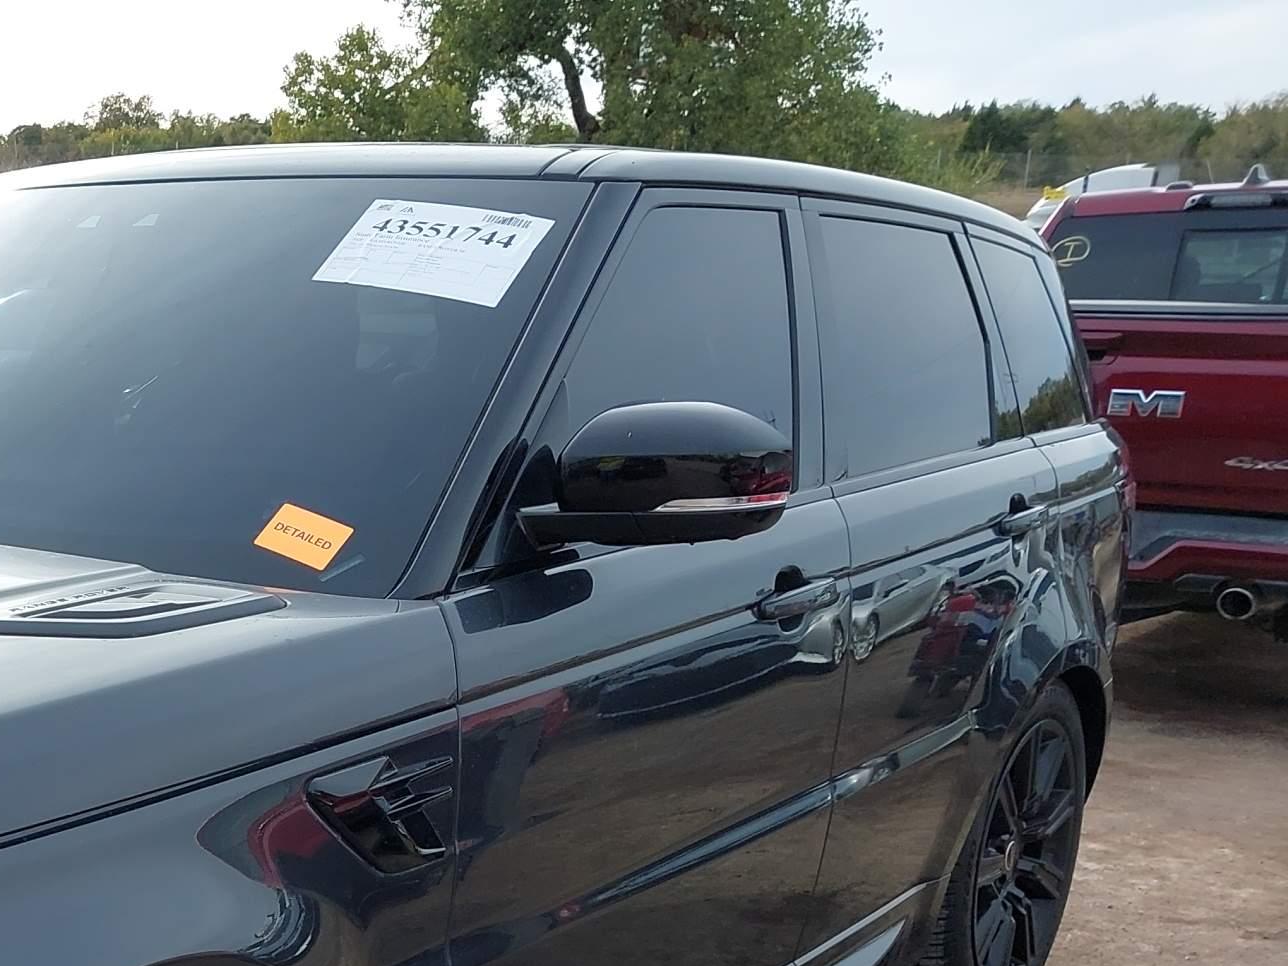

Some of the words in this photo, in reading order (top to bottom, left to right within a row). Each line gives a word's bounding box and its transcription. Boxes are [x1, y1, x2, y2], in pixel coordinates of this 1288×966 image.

[372, 217, 517, 249] 43551744
[273, 521, 333, 551] DETAILED
[72, 585, 130, 600] ROVER
